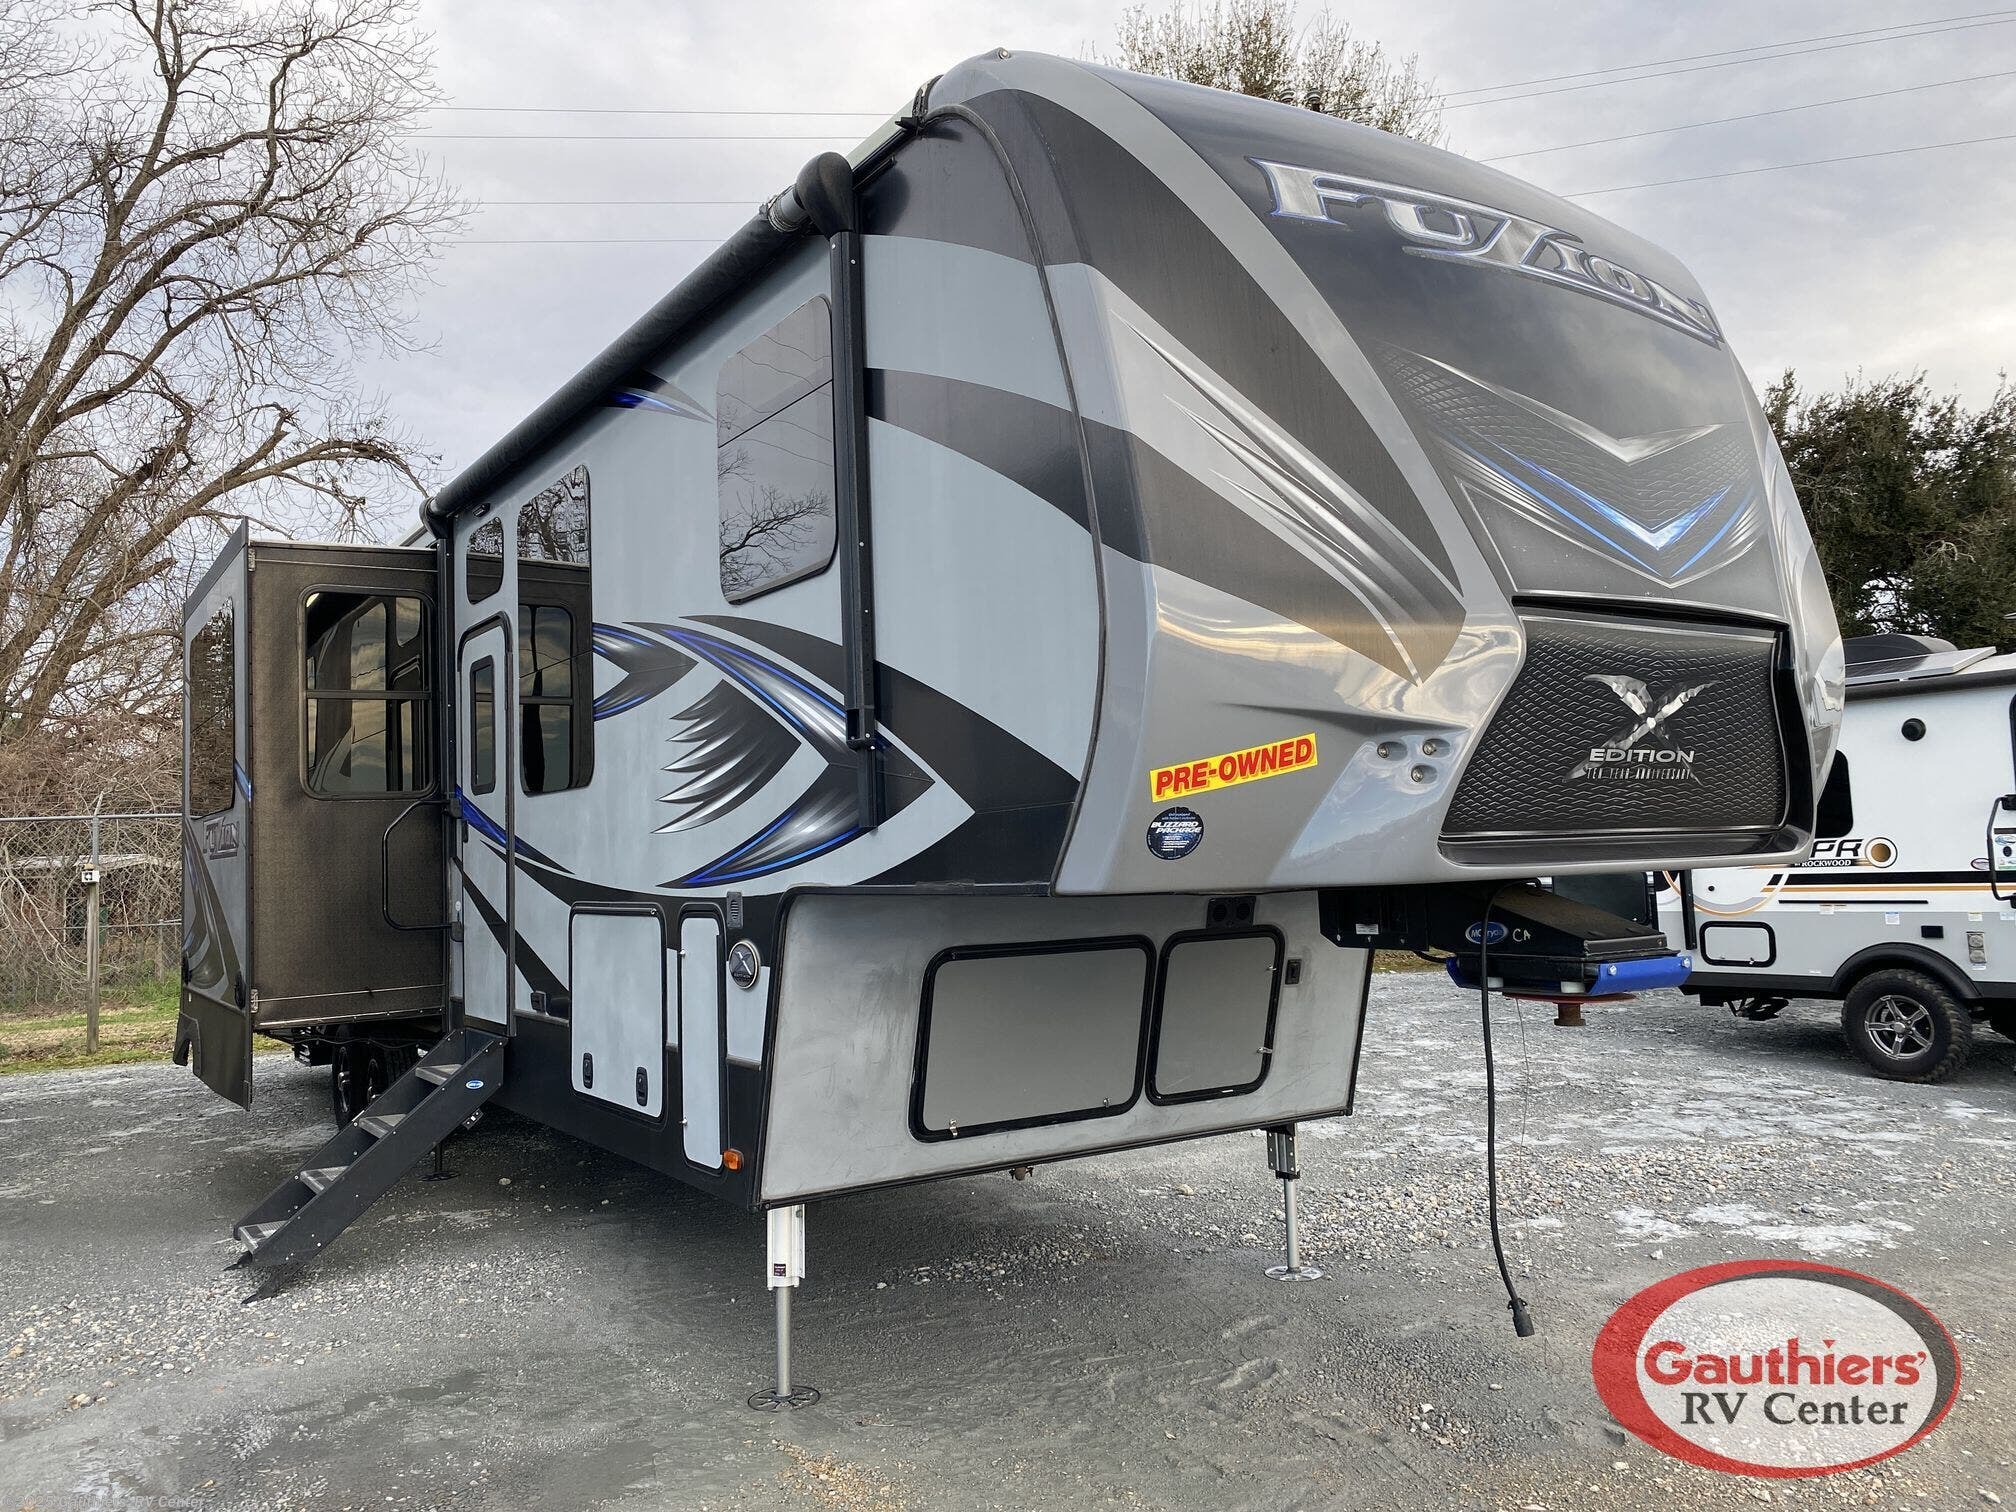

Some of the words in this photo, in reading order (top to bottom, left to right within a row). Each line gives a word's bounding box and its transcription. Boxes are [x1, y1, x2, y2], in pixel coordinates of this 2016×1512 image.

[1589, 748, 1695, 763] EDITION
[1155, 737, 1313, 797] PRE-OWNED
[1801, 859, 1852, 867] ROCKWOOD
